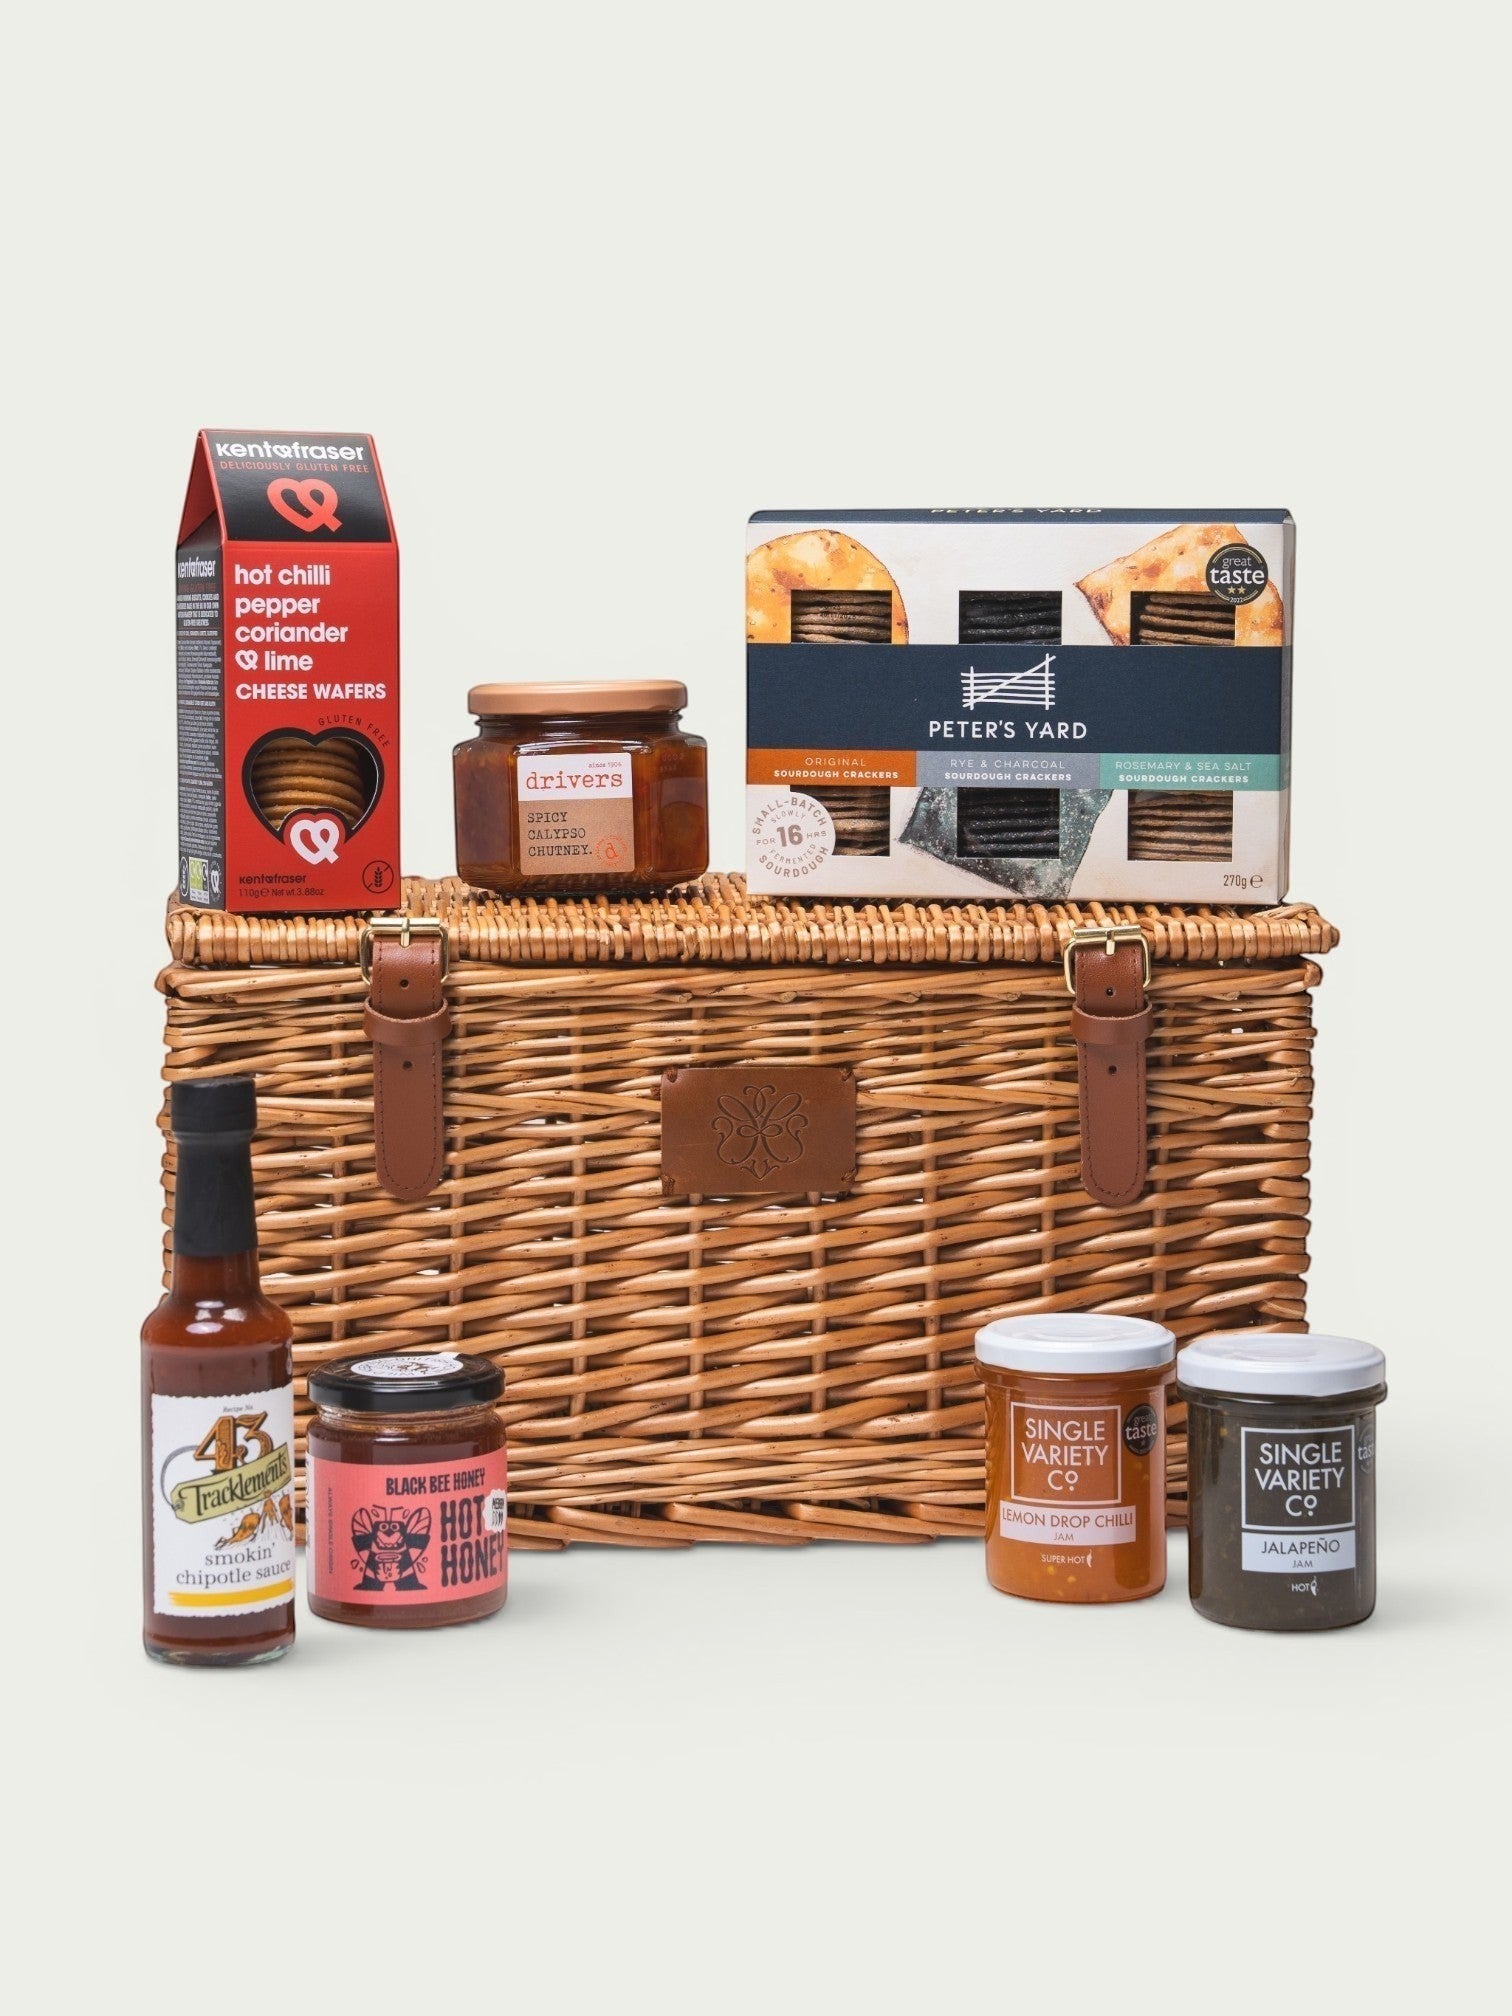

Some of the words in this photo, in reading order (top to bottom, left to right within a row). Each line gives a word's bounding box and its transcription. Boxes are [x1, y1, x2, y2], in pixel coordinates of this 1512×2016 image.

[220, 461, 290, 471] DELICIOUSLY
[296, 462, 338, 472] GLUTEN
[343, 464, 369, 473] FREE
[1222, 556, 1252, 569] great
[235, 564, 272, 585] hot
[278, 565, 330, 585] chilli
[1209, 568, 1265, 584] taste
[235, 597, 320, 618] pepper
[235, 622, 348, 642] coriander
[265, 651, 313, 671] lime
[235, 683, 308, 700] CHEESE
[313, 683, 386, 699] WAFERS
[318, 714, 362, 726] GLUTEN
[367, 723, 390, 747] FREE
[929, 720, 1016, 739] PETER'S
[1025, 722, 1087, 740] YARD
[805, 757, 867, 767] ORIGINAL
[951, 759, 974, 768] RYE
[980, 759, 988, 768] &
[994, 760, 1065, 769] CHARCOAL
[1116, 761, 1180, 770] ROSEMARY
[1185, 762, 1192, 771] &
[1197, 762, 1219, 771] SEA
[1224, 762, 1252, 771] SALT
[526, 771, 623, 790] drivers
[774, 769, 839, 779] SOURDOUGH
[843, 770, 899, 780] CRACKERS
[944, 771, 1011, 781] SOURDOUGH
[1015, 772, 1072, 782] CRACKERS
[1118, 774, 1187, 783] SOURDOUGH
[1191, 774, 1249, 784] CRACKERS
[527, 811, 568, 823] SPICY
[770, 809, 806, 824] SLOWLY
[527, 828, 586, 840] CALYPSO
[756, 837, 776, 845] FOR
[776, 824, 804, 847] 16
[806, 830, 827, 839] HRS
[528, 844, 593, 857] CHUTNEY.
[758, 846, 829, 878] SOURDOUGH
[1223, 874, 1247, 889] 270g
[1026, 1418, 1105, 1442] SINGLE
[1125, 1423, 1157, 1440] taste
[193, 1411, 274, 1475] 43
[1022, 1442, 1109, 1466] VARIETY
[1259, 1442, 1342, 1465] SINGLE
[178, 1452, 289, 1516] Tracklements
[386, 1477, 427, 1496] BLACK
[429, 1474, 451, 1492] BEE
[453, 1467, 486, 1491] HONEY
[1254, 1467, 1345, 1491] VARIETY
[440, 1494, 485, 1543] HOT
[1002, 1509, 1045, 1526] LEMON
[1051, 1515, 1090, 1528] DROP
[1095, 1512, 1133, 1527] CHILLI
[1053, 1533, 1075, 1541] JAM
[1261, 1537, 1341, 1555] JALAPEÑO
[205, 1542, 276, 1566] smokin'
[441, 1529, 505, 1588] HONEY
[1041, 1554, 1065, 1564] SUPER
[1067, 1556, 1085, 1564] HOT
[1292, 1560, 1313, 1568] JAM
[176, 1567, 251, 1589] chipotle
[256, 1560, 291, 1580] sauce
[1292, 1583, 1310, 1592] HOT
